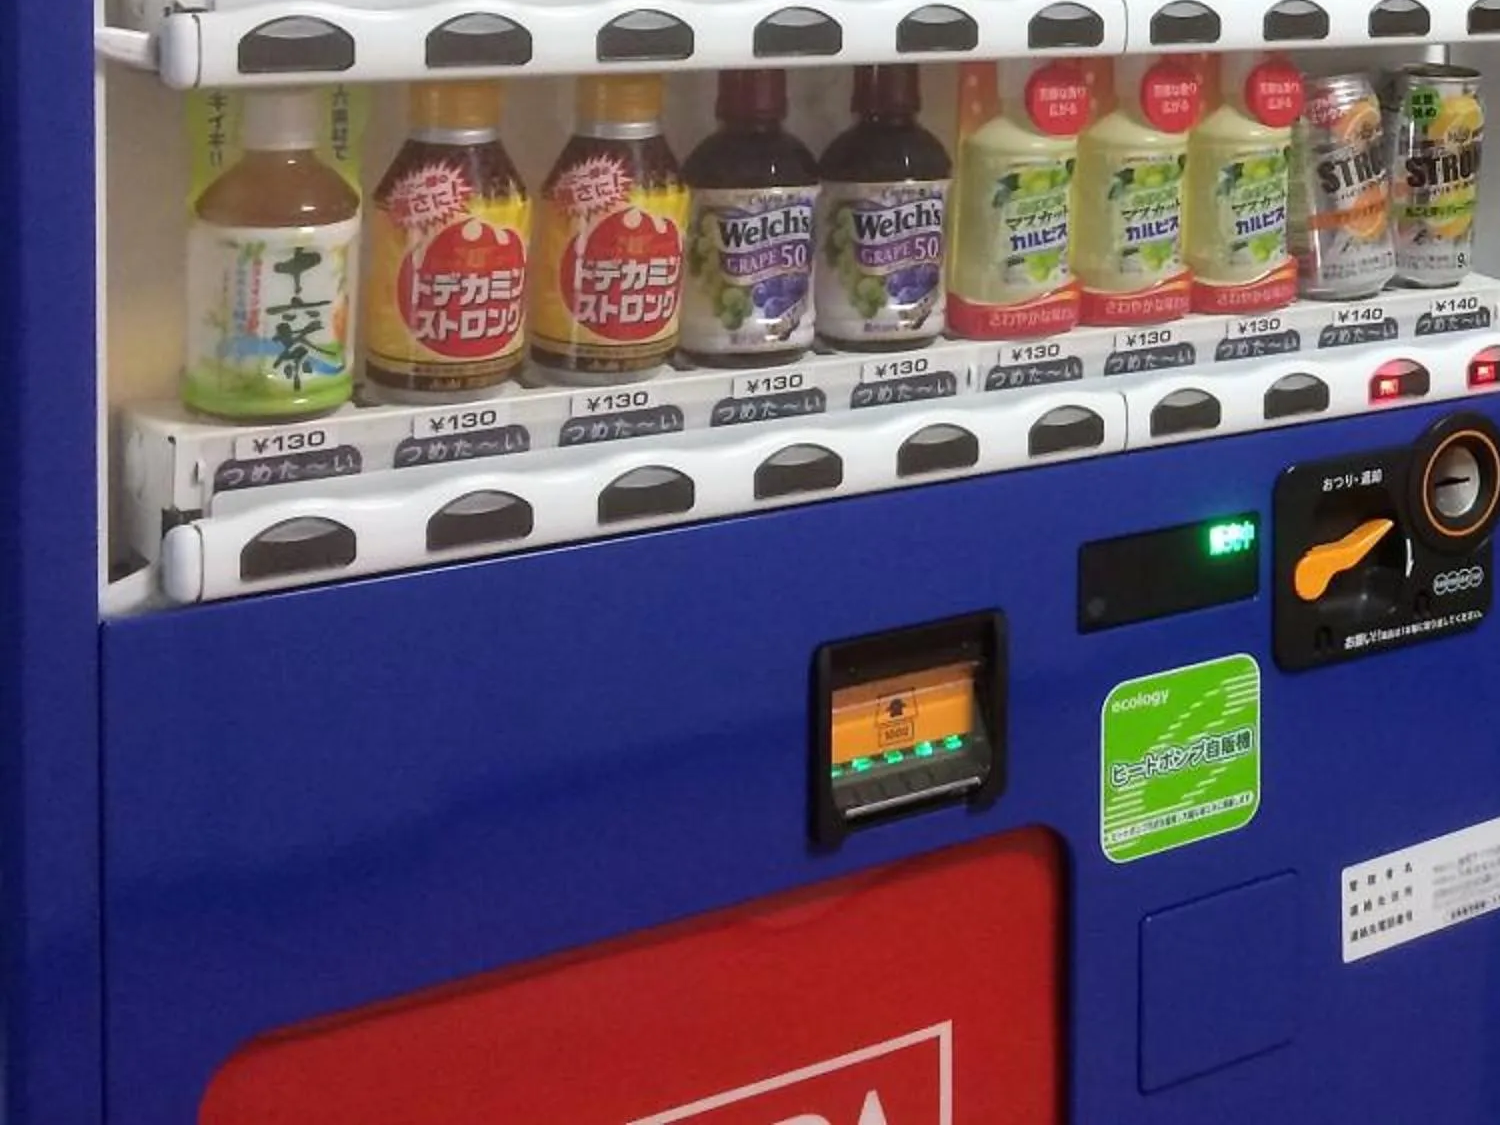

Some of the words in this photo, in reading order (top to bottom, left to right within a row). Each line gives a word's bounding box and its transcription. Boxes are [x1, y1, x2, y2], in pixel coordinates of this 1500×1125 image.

[719, 209, 812, 247] Welch's
[853, 203, 942, 239] Welch's
[727, 248, 779, 274] GRAPE
[781, 244, 807, 268] 50
[861, 241, 912, 266] GRAPE
[915, 236, 940, 261] 50
[412, 267, 525, 303] ドデカミン
[575, 256, 681, 291] ドデカミン
[577, 293, 676, 324] ストロング
[1337, 308, 1383, 323] ¥140
[1435, 297, 1479, 313] ¥140
[266, 246, 336, 391] 十六茶
[416, 306, 520, 340] ストロング
[1238, 318, 1281, 334] ¥130
[1126, 330, 1170, 347] ¥130
[1011, 344, 1061, 362] ¥130
[875, 358, 928, 377] ¥130
[747, 375, 803, 394] ¥130
[587, 391, 649, 412] ¥130
[429, 410, 497, 431] ¥130
[252, 431, 325, 453] ¥130
[1112, 688, 1169, 713] ecology
[1111, 728, 1253, 787] ヒートポンプ自販機
